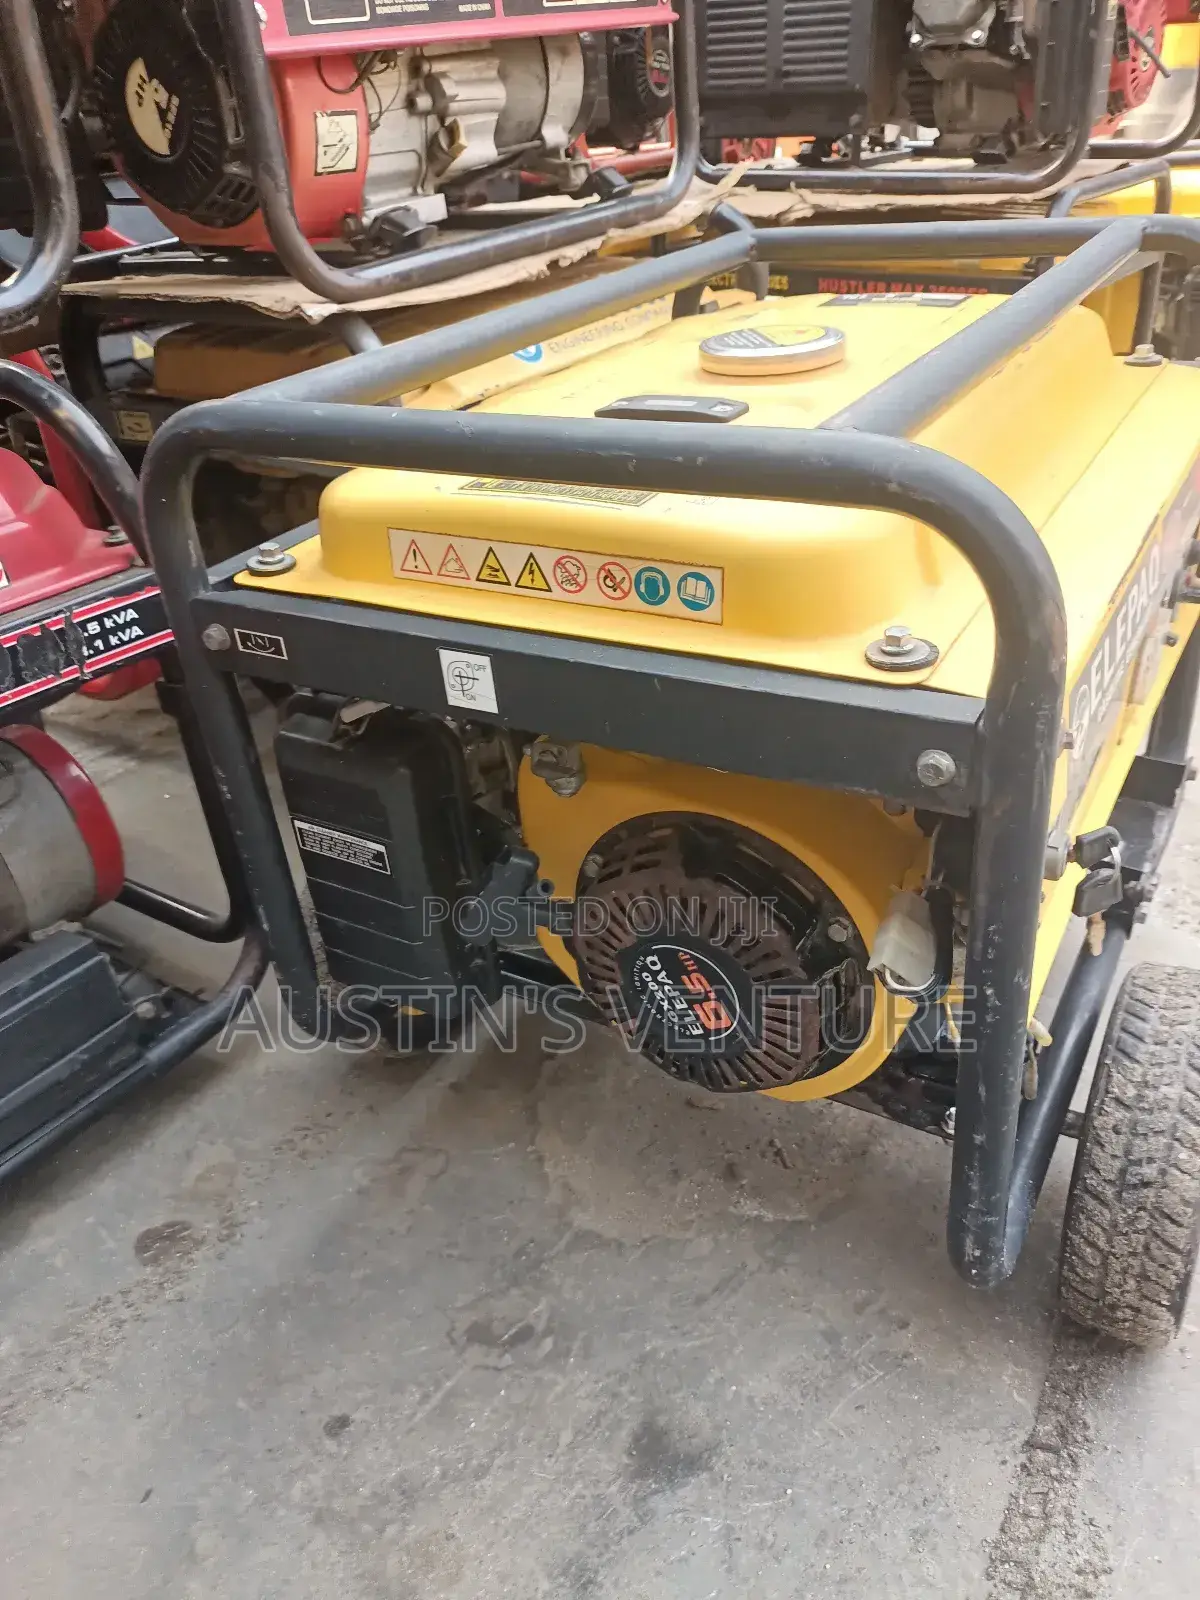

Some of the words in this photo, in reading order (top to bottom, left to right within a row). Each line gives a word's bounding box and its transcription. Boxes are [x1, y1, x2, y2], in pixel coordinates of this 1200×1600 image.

[818, 278, 887, 294] HUSTLER
[103, 608, 140, 629] kVA
[108, 625, 145, 646] kVA
[1090, 545, 1160, 716] ELEPAQ
[474, 663, 487, 672] OFF
[465, 693, 477, 701] ON
[645, 954, 704, 1036] ELEPAQ
